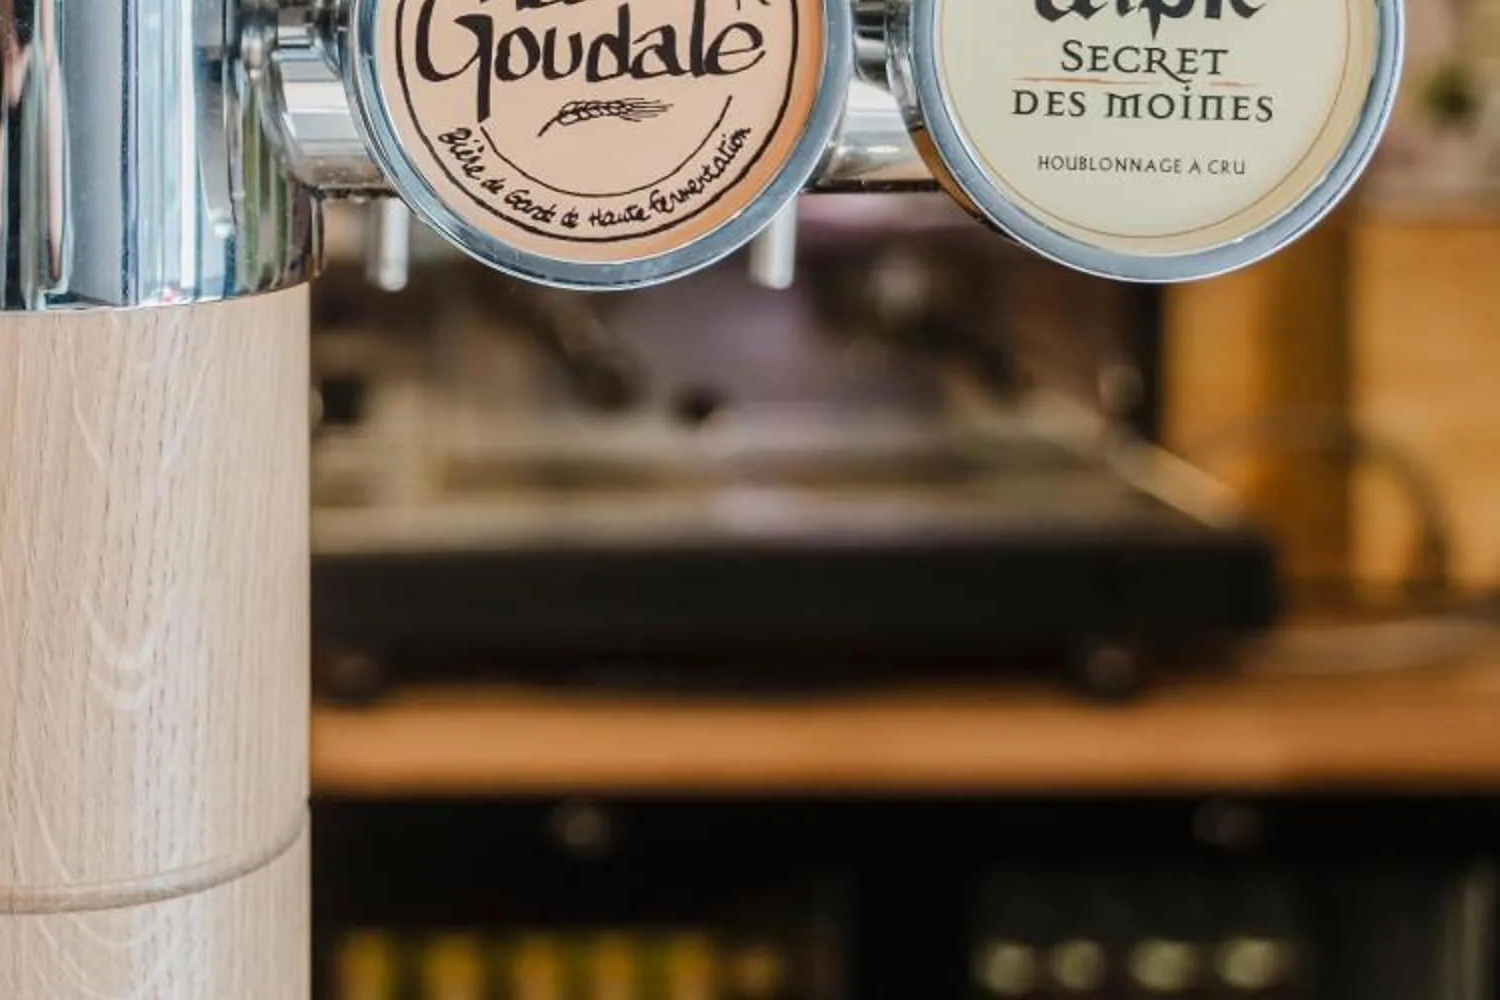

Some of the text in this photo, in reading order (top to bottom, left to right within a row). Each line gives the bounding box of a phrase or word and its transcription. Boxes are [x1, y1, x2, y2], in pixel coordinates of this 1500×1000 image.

[1060, 39, 1230, 84] SECRET
[1011, 89, 1087, 118] DES
[1037, 155, 1246, 175] HOUBLONNAGE A CRU
